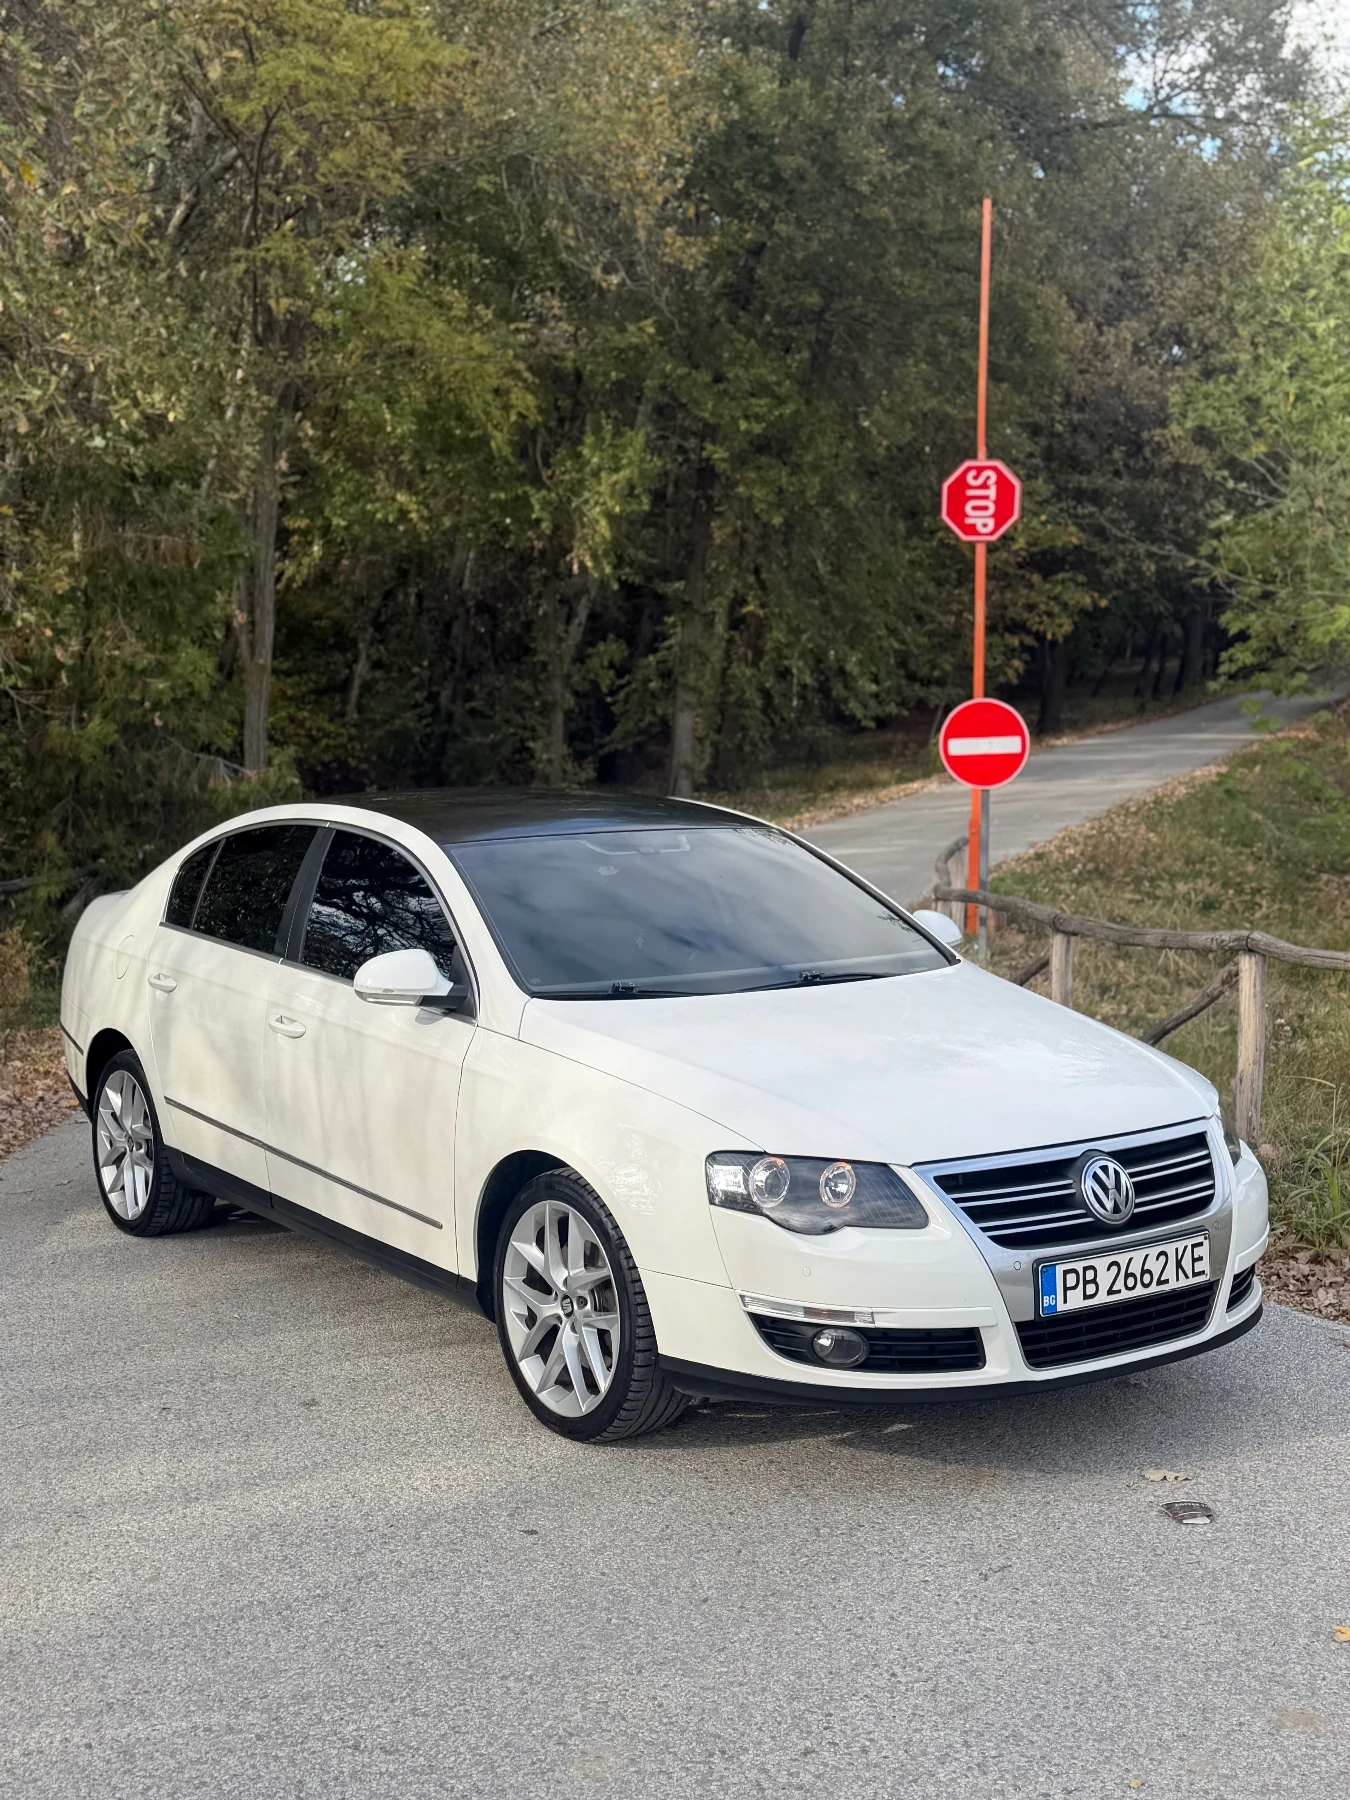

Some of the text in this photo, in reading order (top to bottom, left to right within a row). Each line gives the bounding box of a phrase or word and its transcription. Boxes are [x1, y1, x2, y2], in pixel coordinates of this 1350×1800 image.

[964, 469, 998, 534] STOP
[1043, 1294, 1056, 1308] BG
[1062, 1241, 1206, 1305] PB 2662 KE
